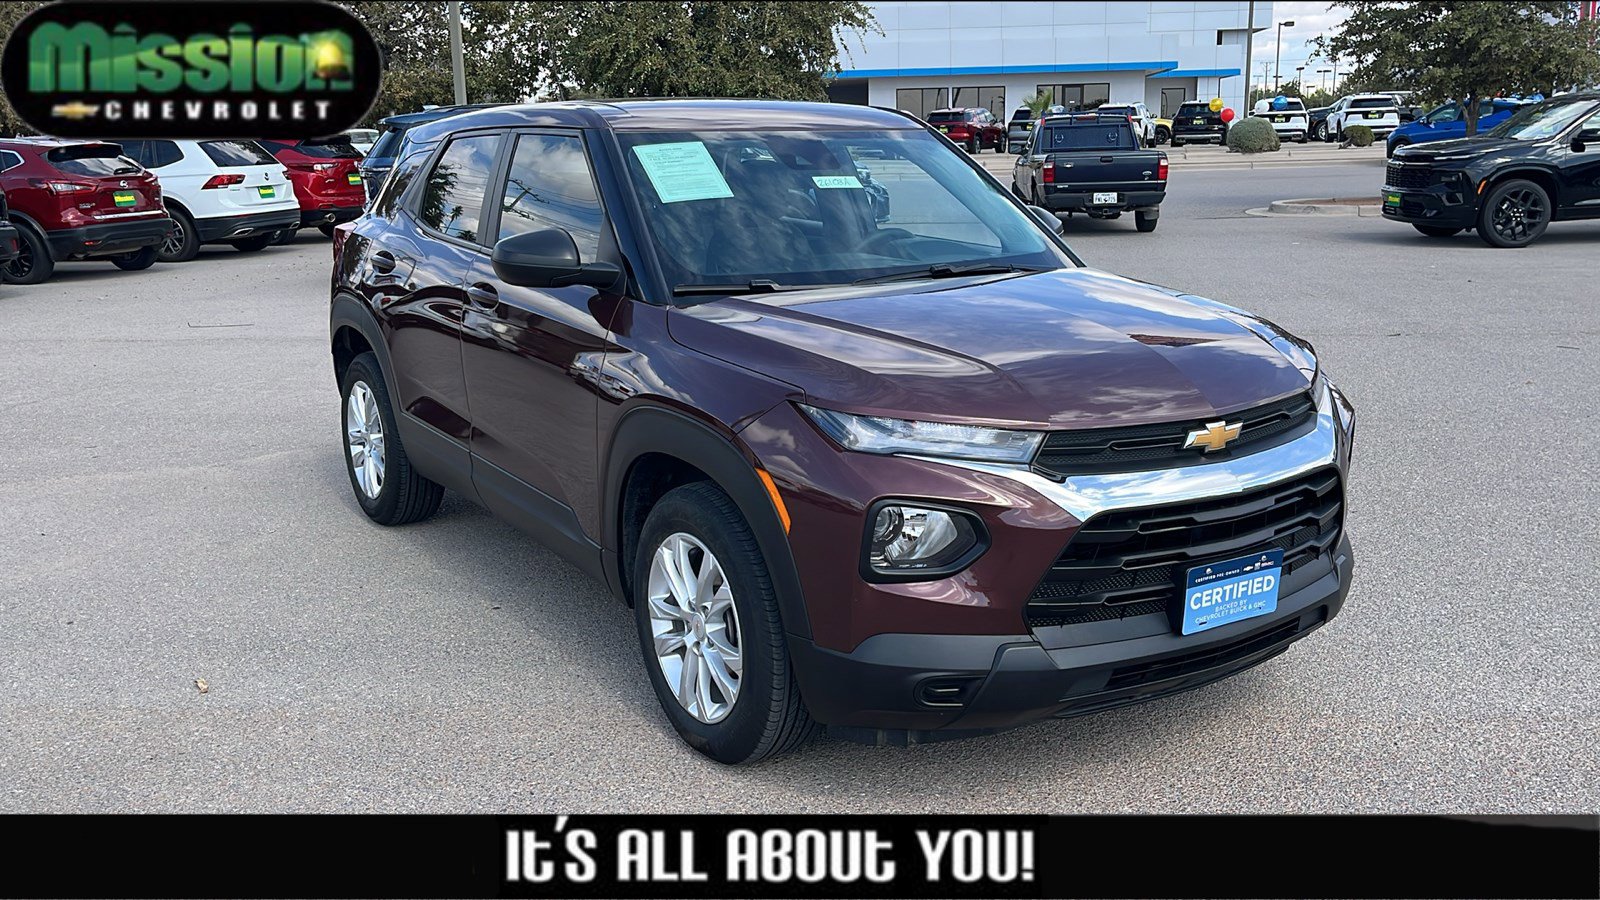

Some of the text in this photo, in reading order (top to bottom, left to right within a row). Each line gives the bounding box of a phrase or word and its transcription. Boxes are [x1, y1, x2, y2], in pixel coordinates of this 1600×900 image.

[1190, 575, 1275, 610] CERTIFIED
[1195, 610, 1229, 624] CHEVROLET
[1229, 604, 1248, 615] BUICK
[1253, 600, 1266, 608] GMC
[1215, 601, 1238, 613] BACKED
